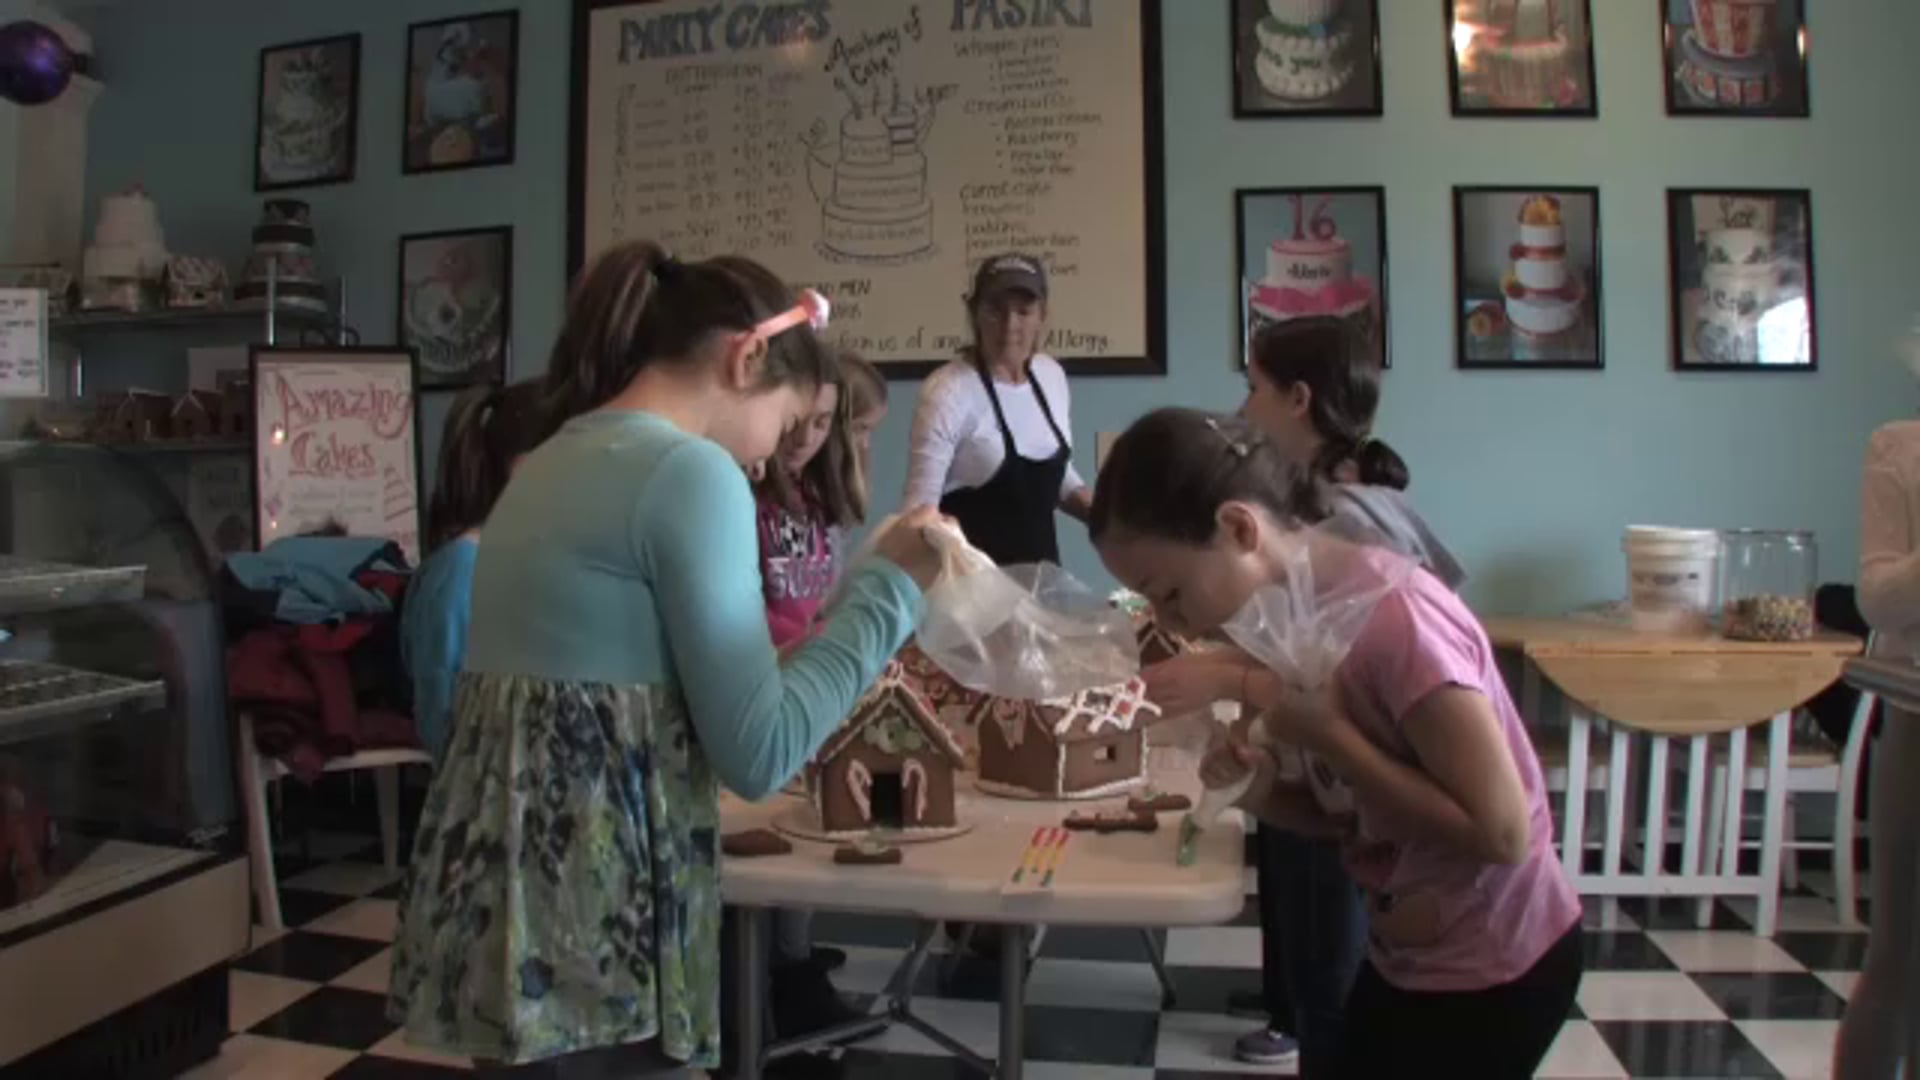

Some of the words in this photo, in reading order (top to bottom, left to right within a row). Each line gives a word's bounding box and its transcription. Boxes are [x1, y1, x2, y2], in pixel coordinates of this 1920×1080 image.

[617, 4, 723, 66] PARTY
[1288, 192, 1337, 242] 16
[276, 374, 409, 441] Amazing
[288, 432, 376, 480] Cakes
